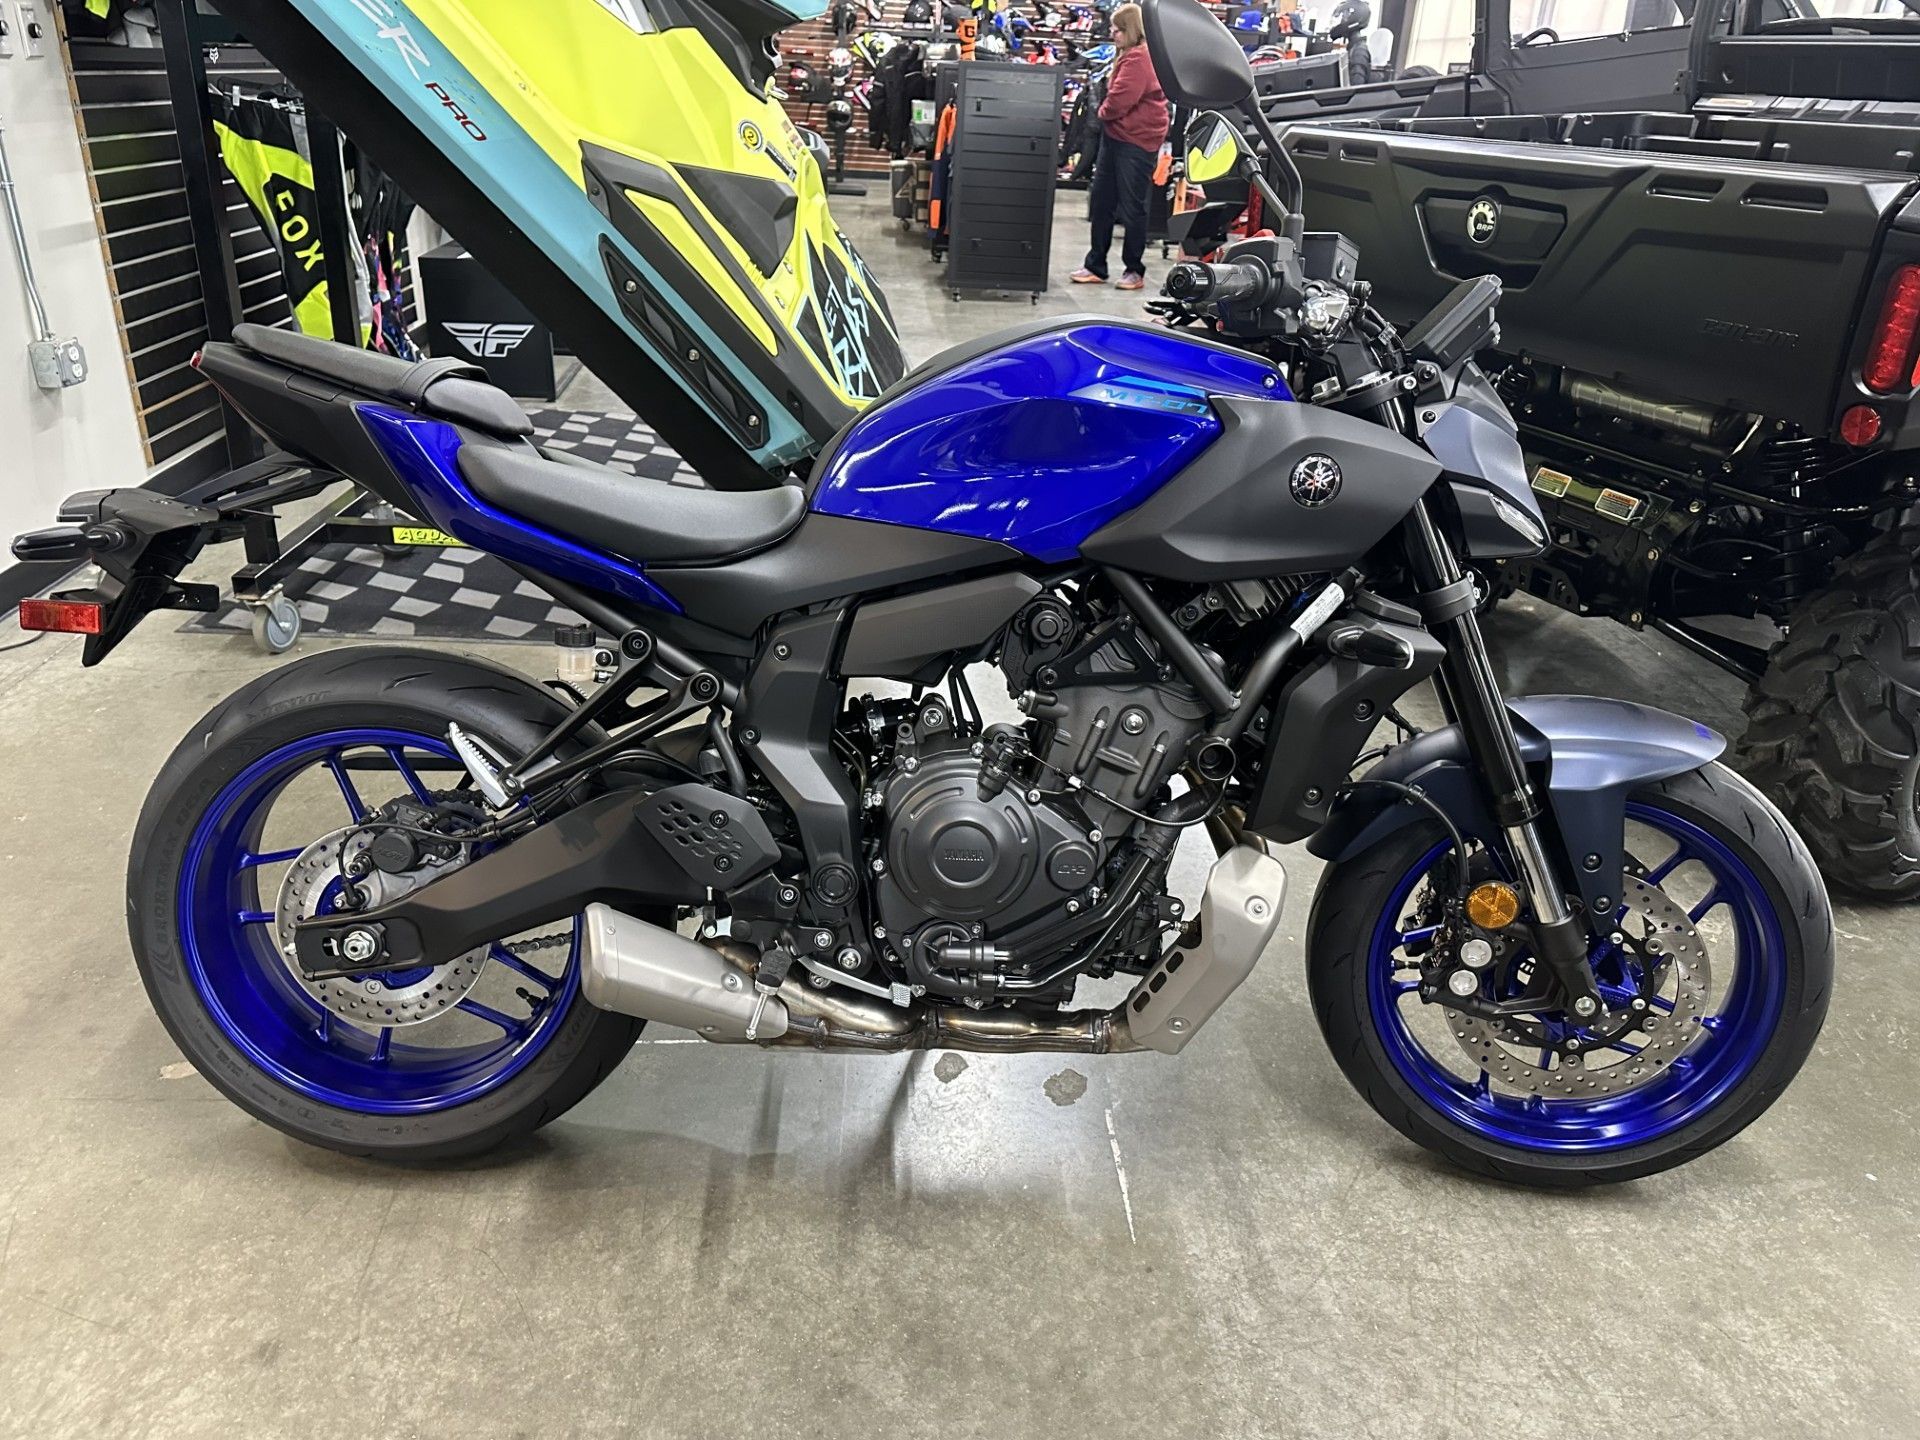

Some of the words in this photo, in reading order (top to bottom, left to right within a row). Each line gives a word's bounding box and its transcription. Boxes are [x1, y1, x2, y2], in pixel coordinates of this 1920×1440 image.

[424, 82, 487, 141] PRO
[277, 189, 325, 272] FOX
[1476, 223, 1494, 232] BRP
[1105, 388, 1208, 415] MT-07
